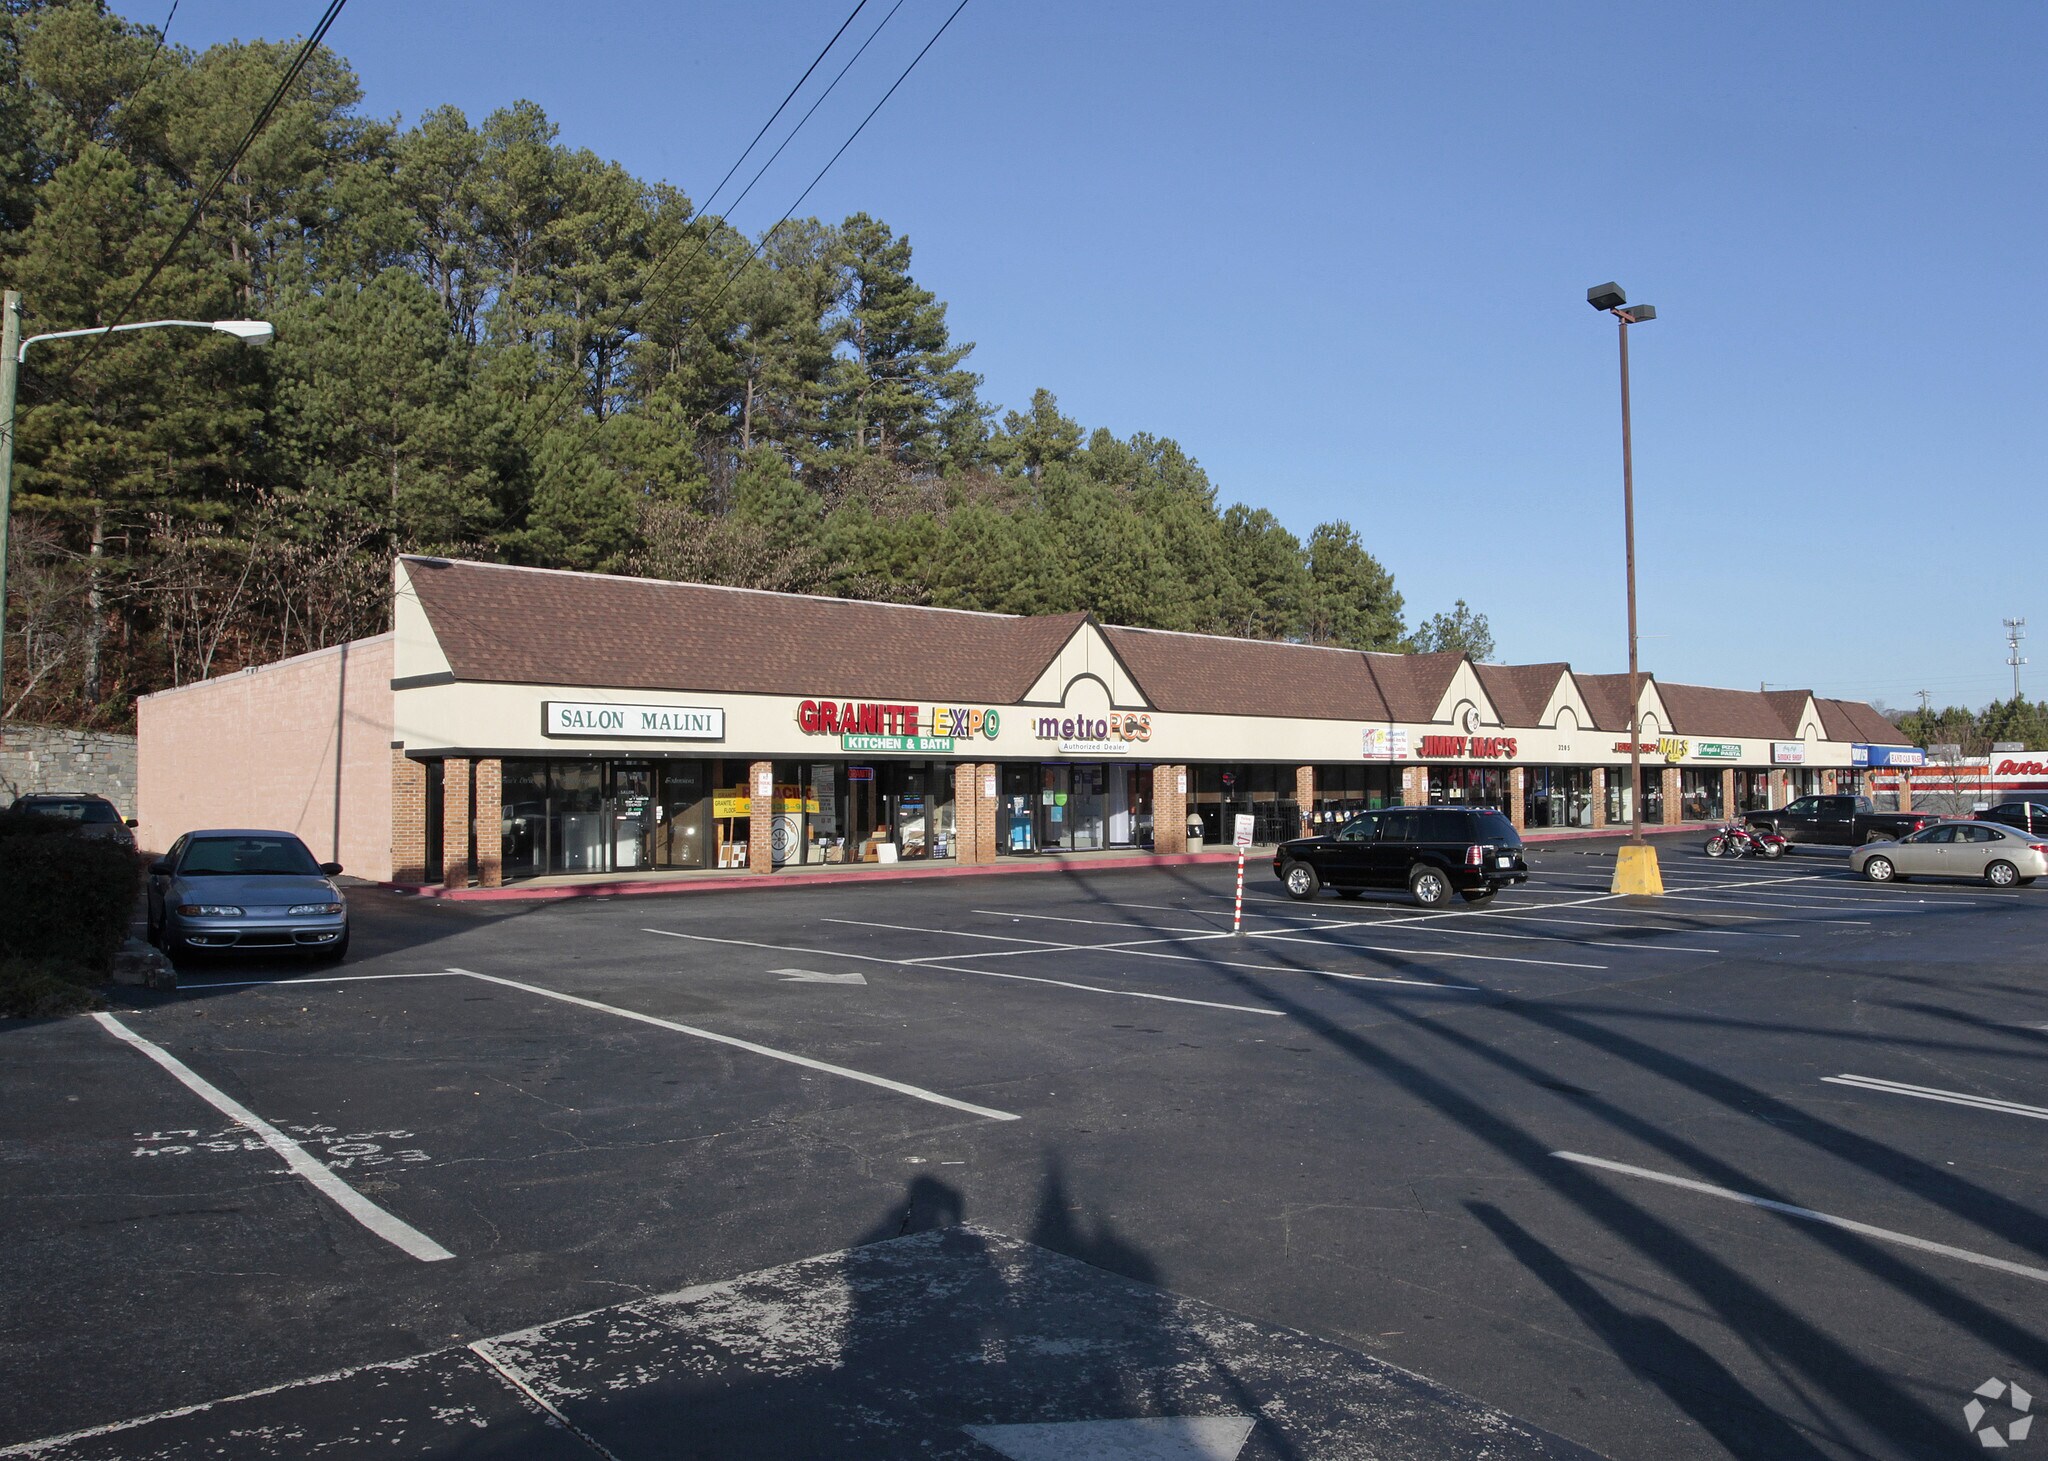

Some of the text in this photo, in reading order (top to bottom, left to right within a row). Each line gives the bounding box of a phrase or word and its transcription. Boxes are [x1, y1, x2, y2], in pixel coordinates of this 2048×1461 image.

[561, 709, 712, 731] SALON MALINI
[799, 700, 1000, 738] GRANITE EXPO
[1036, 713, 1153, 740] metroPCS
[848, 737, 950, 750] KITCHEN & BATH
[1420, 735, 1517, 757] JIMMY MAC'S
[1658, 738, 1688, 755] NAILS
